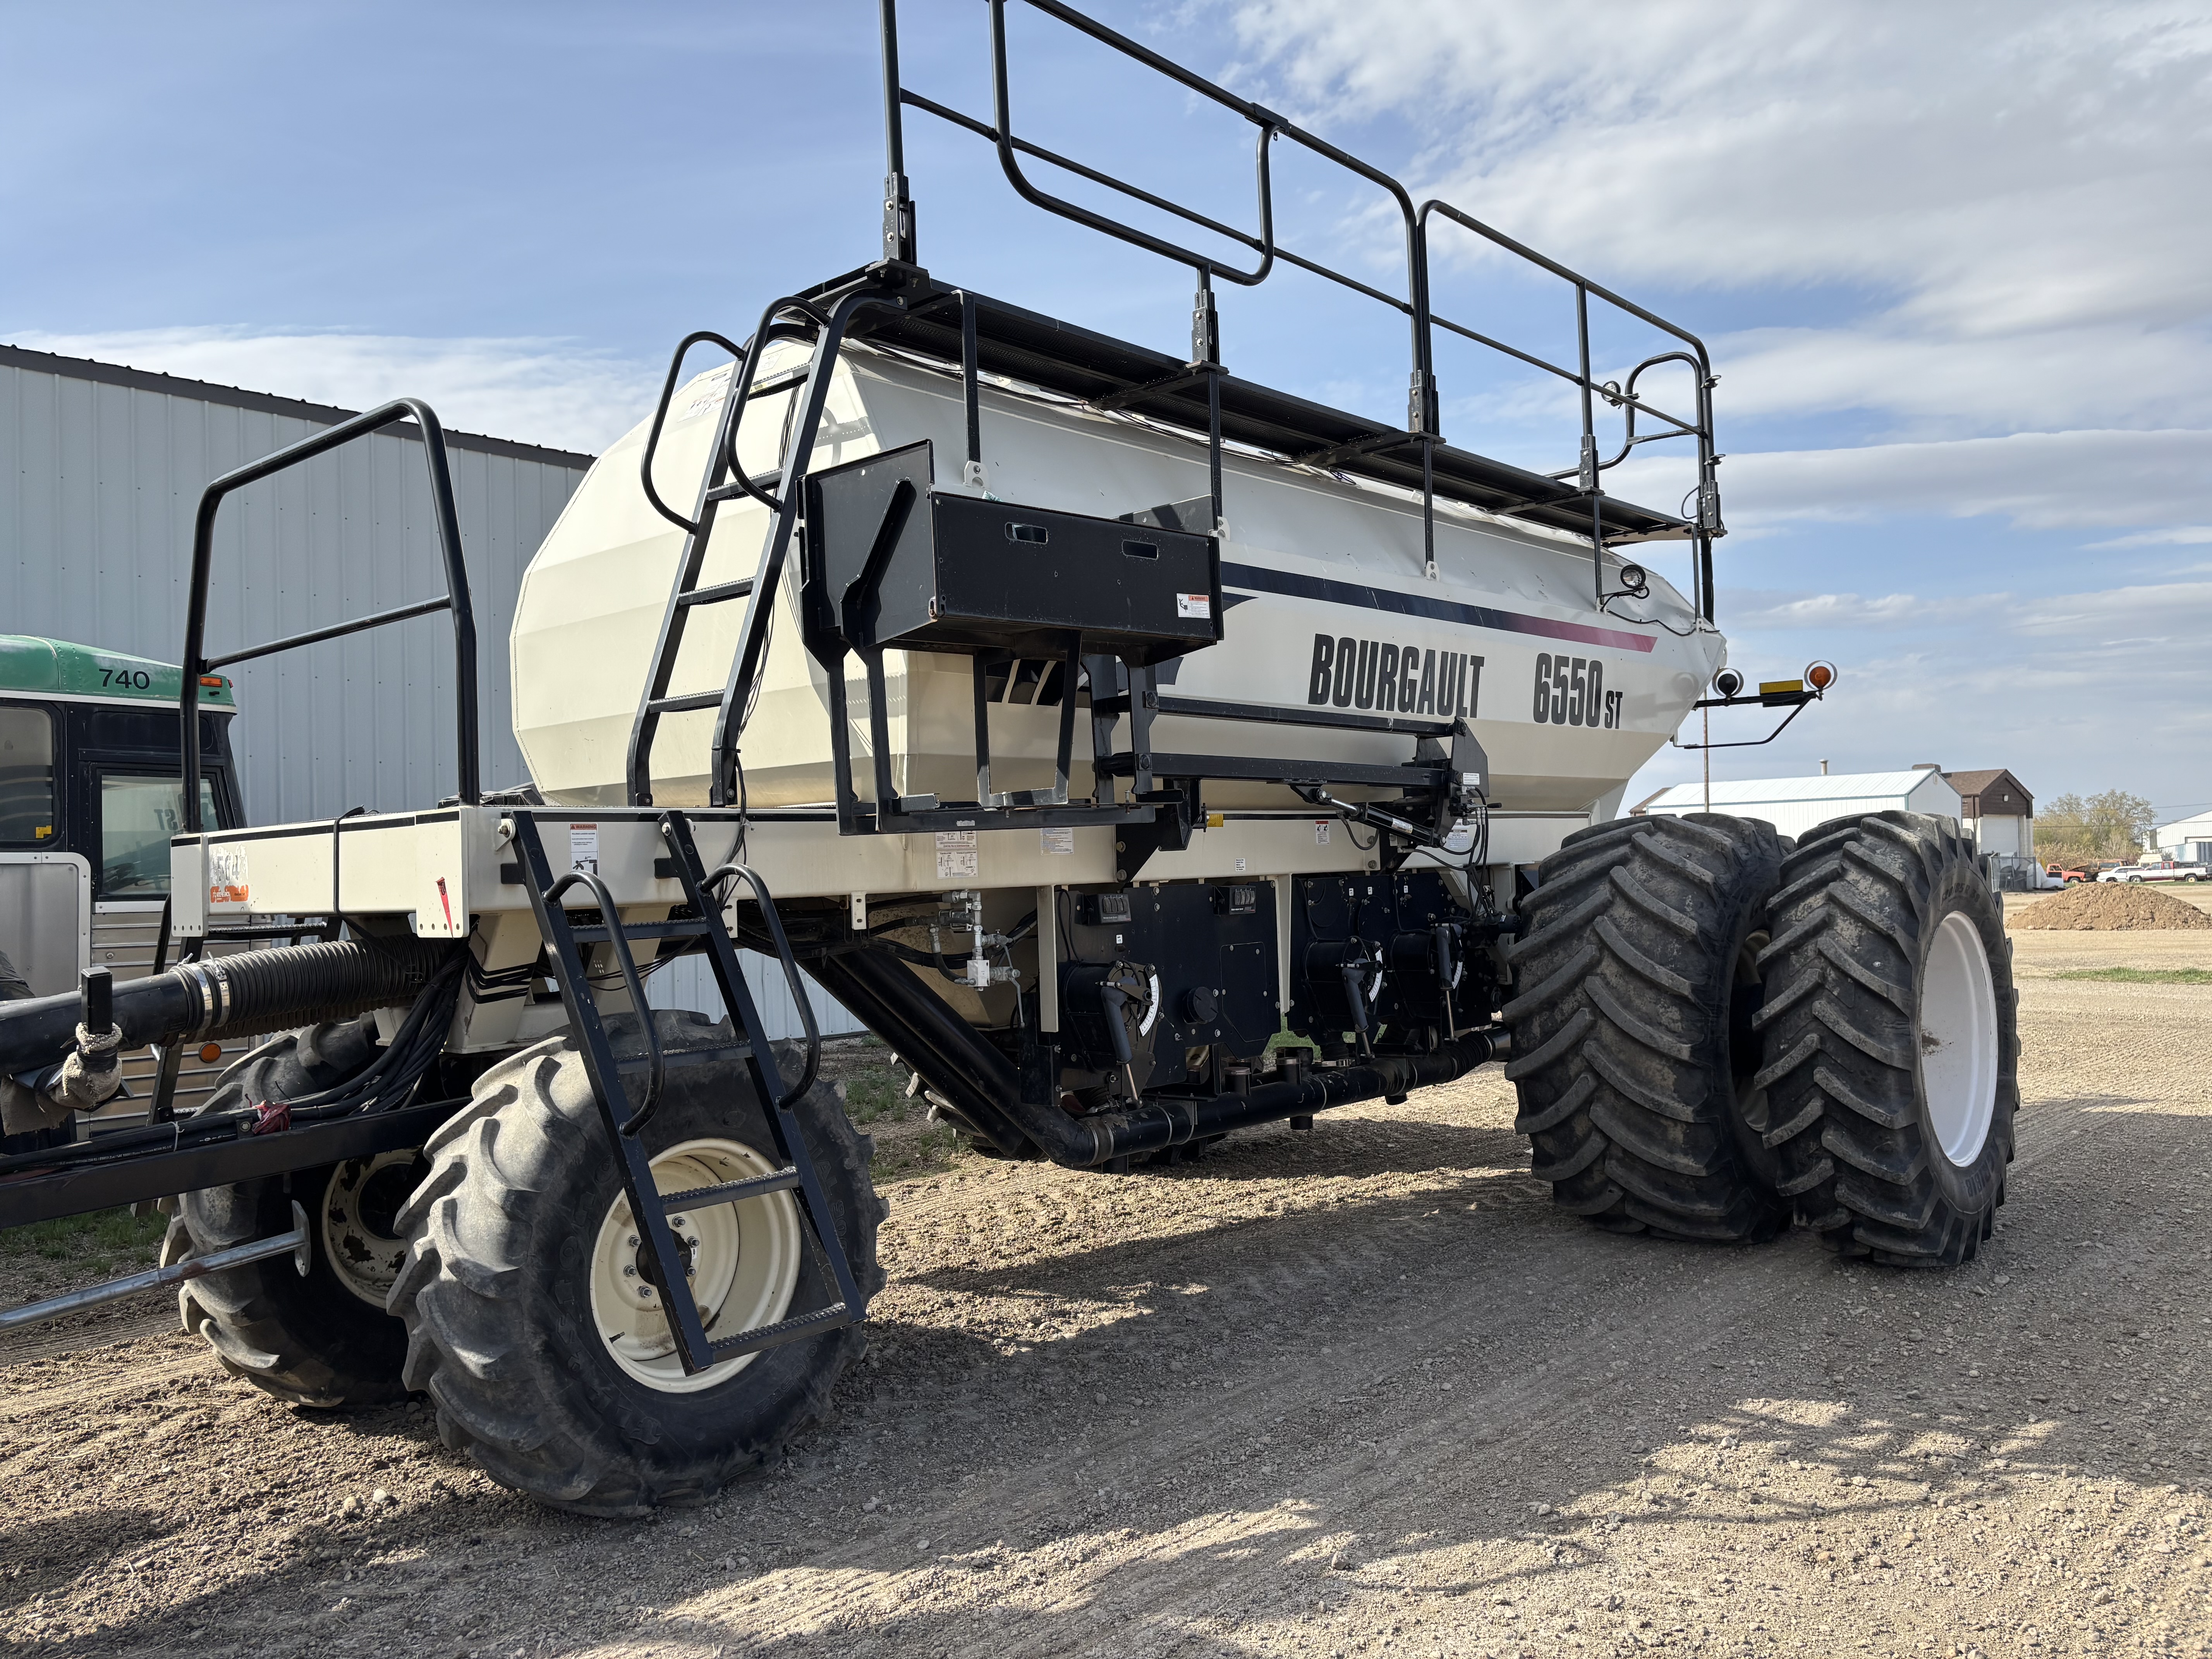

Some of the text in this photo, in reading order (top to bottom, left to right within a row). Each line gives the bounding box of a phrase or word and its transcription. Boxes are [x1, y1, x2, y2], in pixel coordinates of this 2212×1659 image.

[99, 668, 150, 690] 740
[1308, 633, 1623, 729] BOURGAULT 6550 ST
